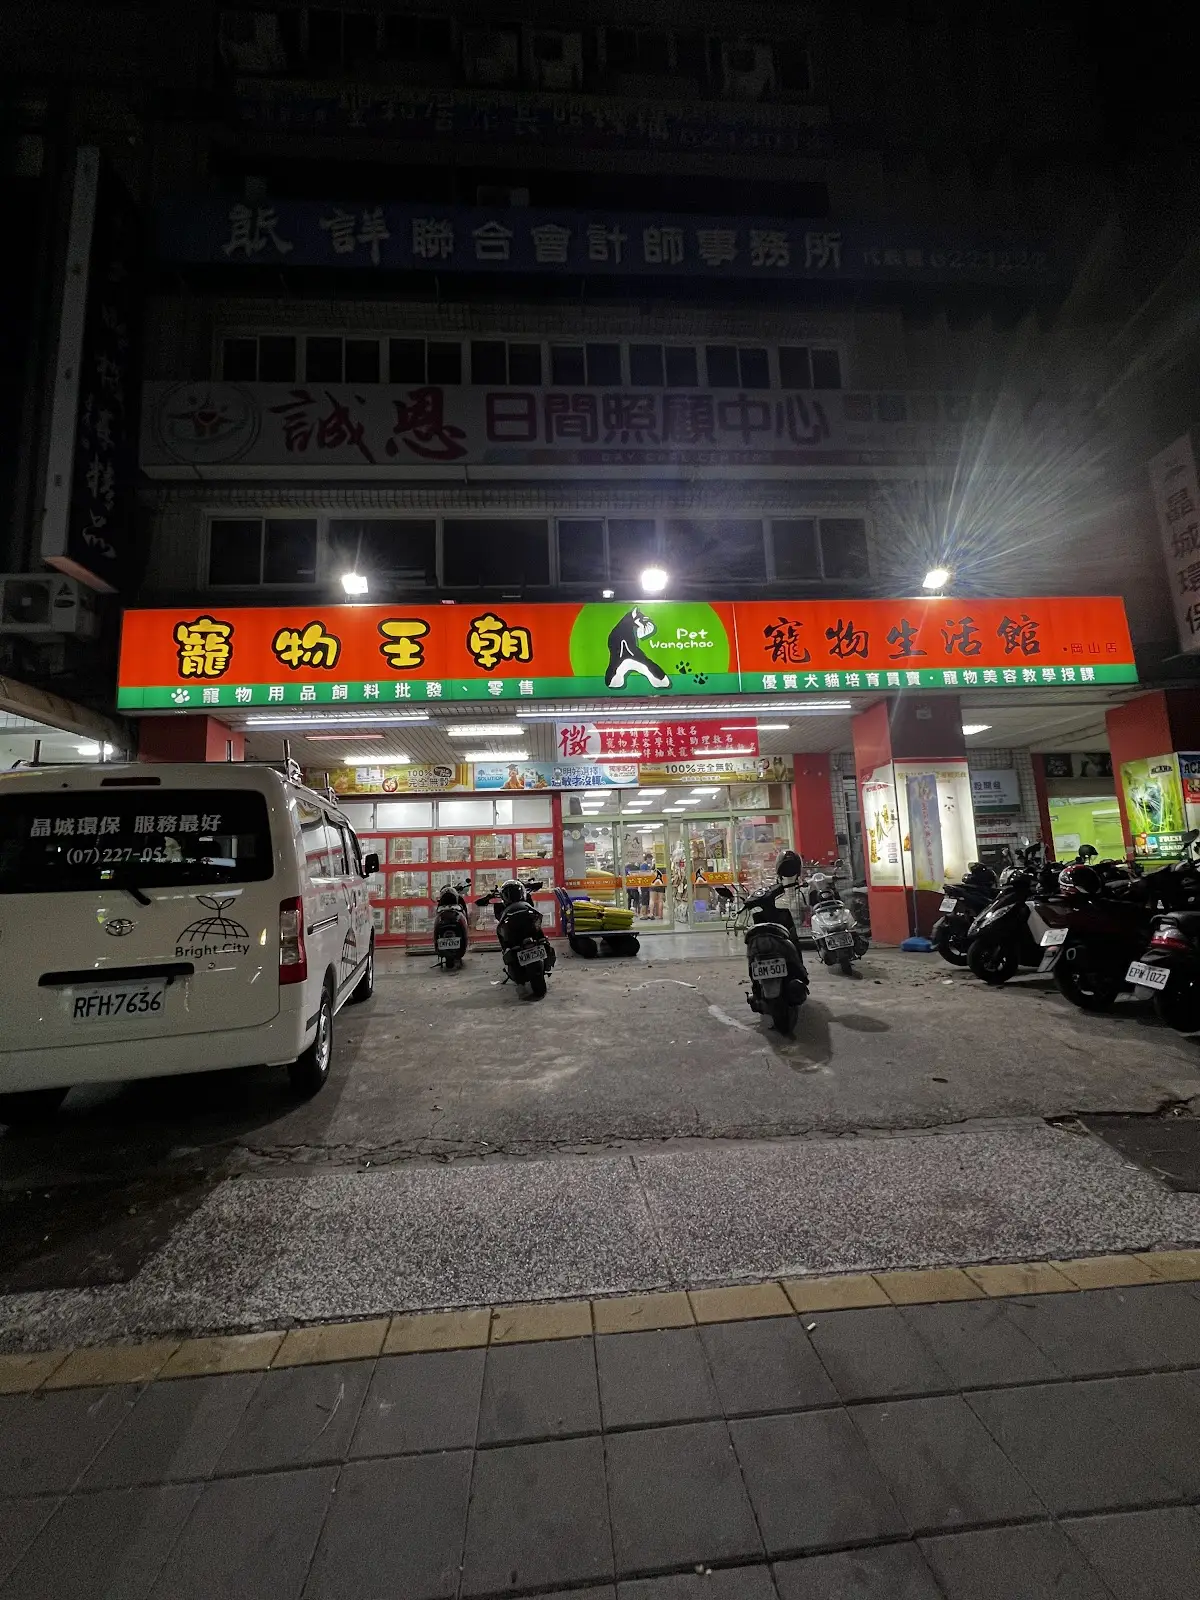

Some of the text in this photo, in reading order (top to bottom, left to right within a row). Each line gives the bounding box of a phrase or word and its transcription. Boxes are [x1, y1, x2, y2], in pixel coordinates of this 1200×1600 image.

[269, 387, 467, 464] 誠恩
[485, 391, 829, 445] 日間照顧中心
[173, 613, 532, 679] 寵物王朝
[649, 639, 714, 652] Wangchao
[676, 627, 708, 640] Pet
[762, 612, 1044, 664] 寵物生活館
[202, 679, 534, 705] 寵物用品飼料批發、零售
[558, 724, 592, 757] 徵
[30, 813, 222, 837] 晶城環保 服務最好
[67, 845, 174, 865] (07)227-05
[175, 943, 250, 959] Bright City
[73, 991, 162, 1018] RFH-7636
